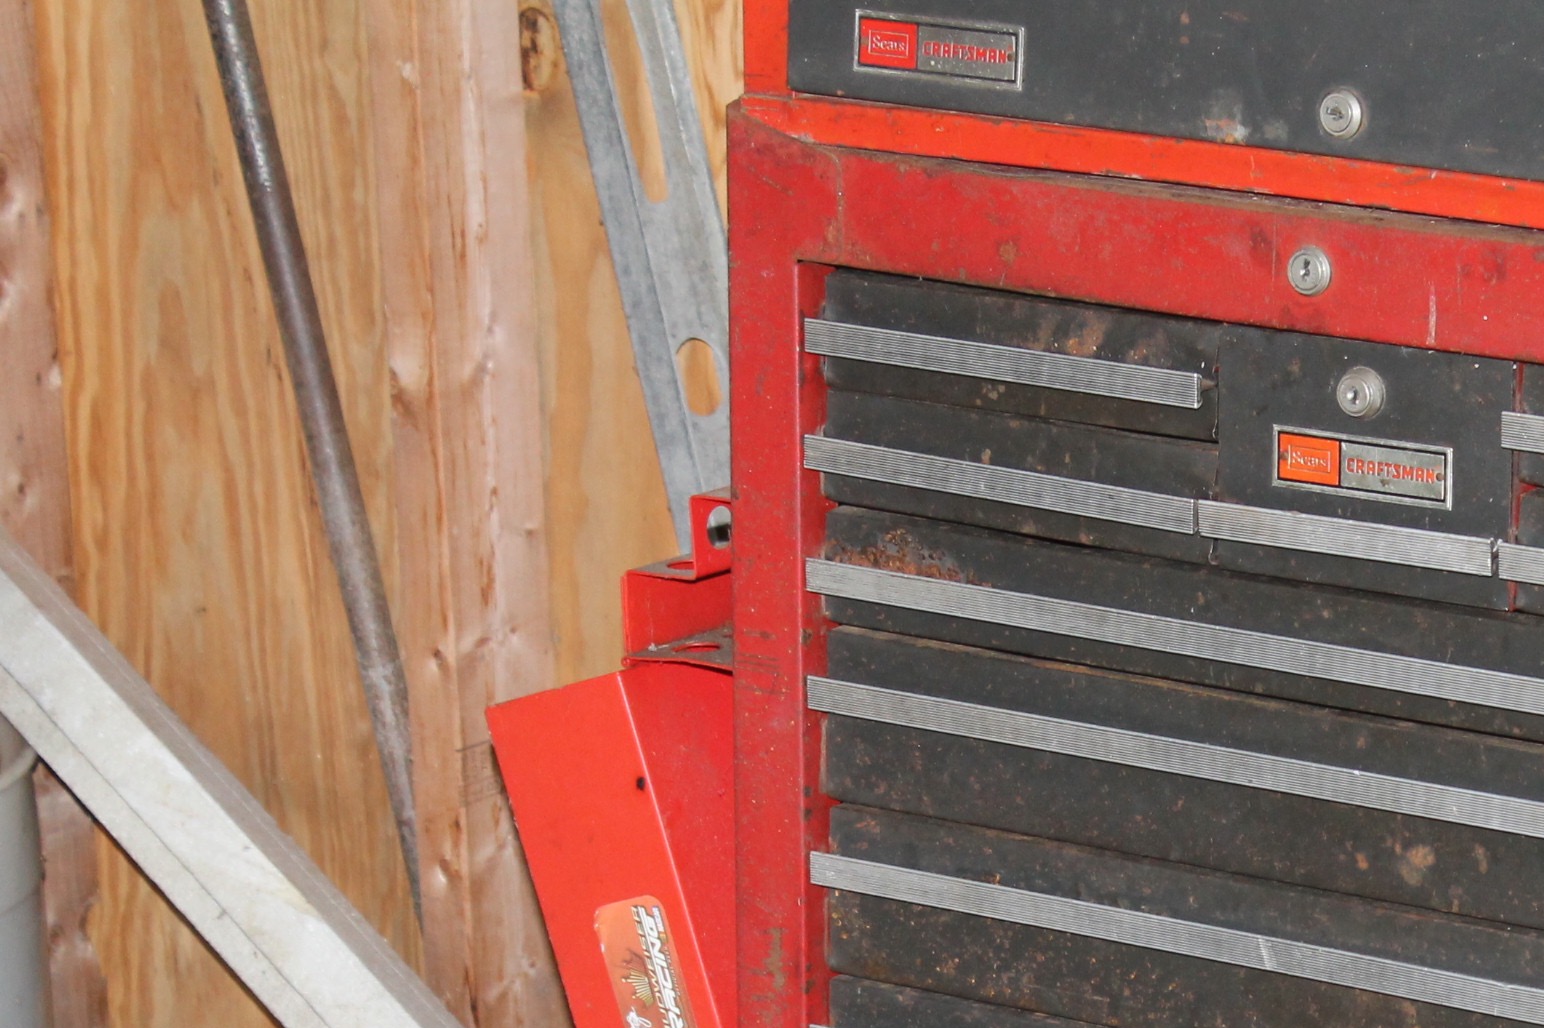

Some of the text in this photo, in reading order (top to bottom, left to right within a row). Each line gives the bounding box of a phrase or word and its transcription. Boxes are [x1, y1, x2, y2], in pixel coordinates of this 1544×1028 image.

[872, 35, 1007, 64] Sears CRAFTSMAN
[1346, 457, 1436, 485] CRAFTSMAN
